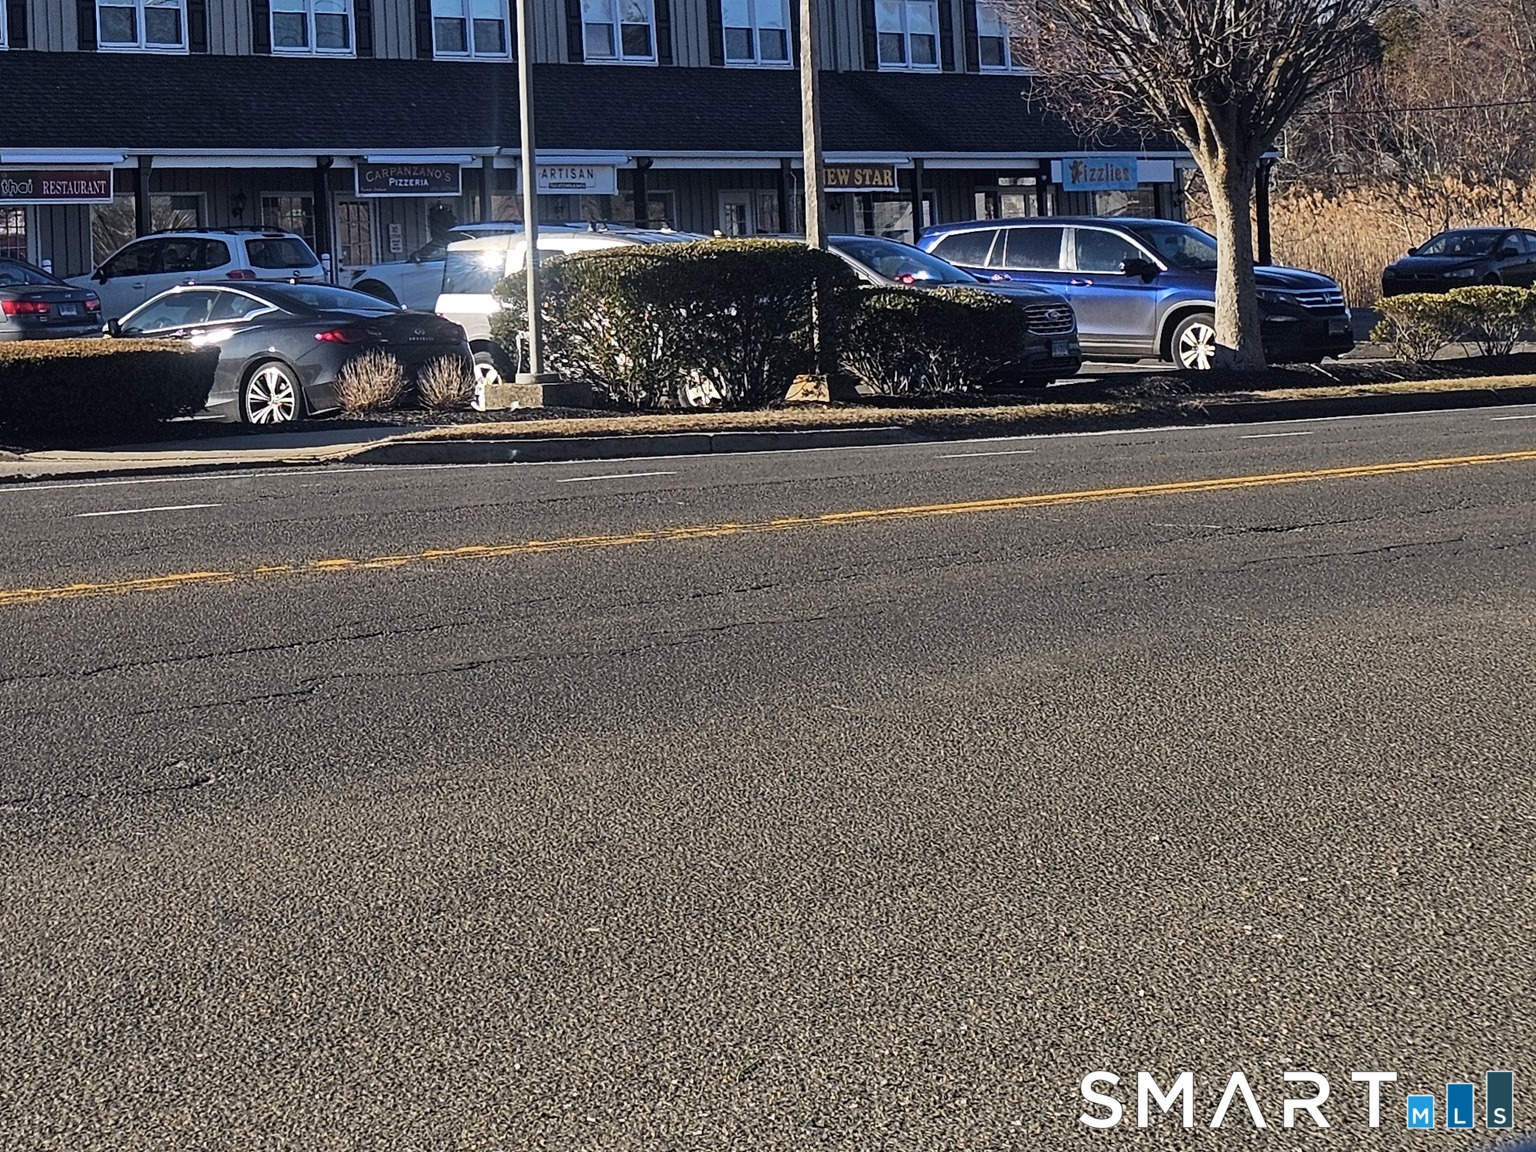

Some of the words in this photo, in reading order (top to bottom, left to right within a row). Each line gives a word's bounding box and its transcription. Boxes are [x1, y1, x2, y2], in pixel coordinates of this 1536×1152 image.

[365, 167, 452, 182] CARPANZANO'S
[541, 168, 594, 179] ARTISAN
[824, 168, 850, 186] EW
[854, 168, 894, 186] STAR
[42, 180, 107, 195] RESTAURANT
[388, 177, 429, 187] PIZZERIA
